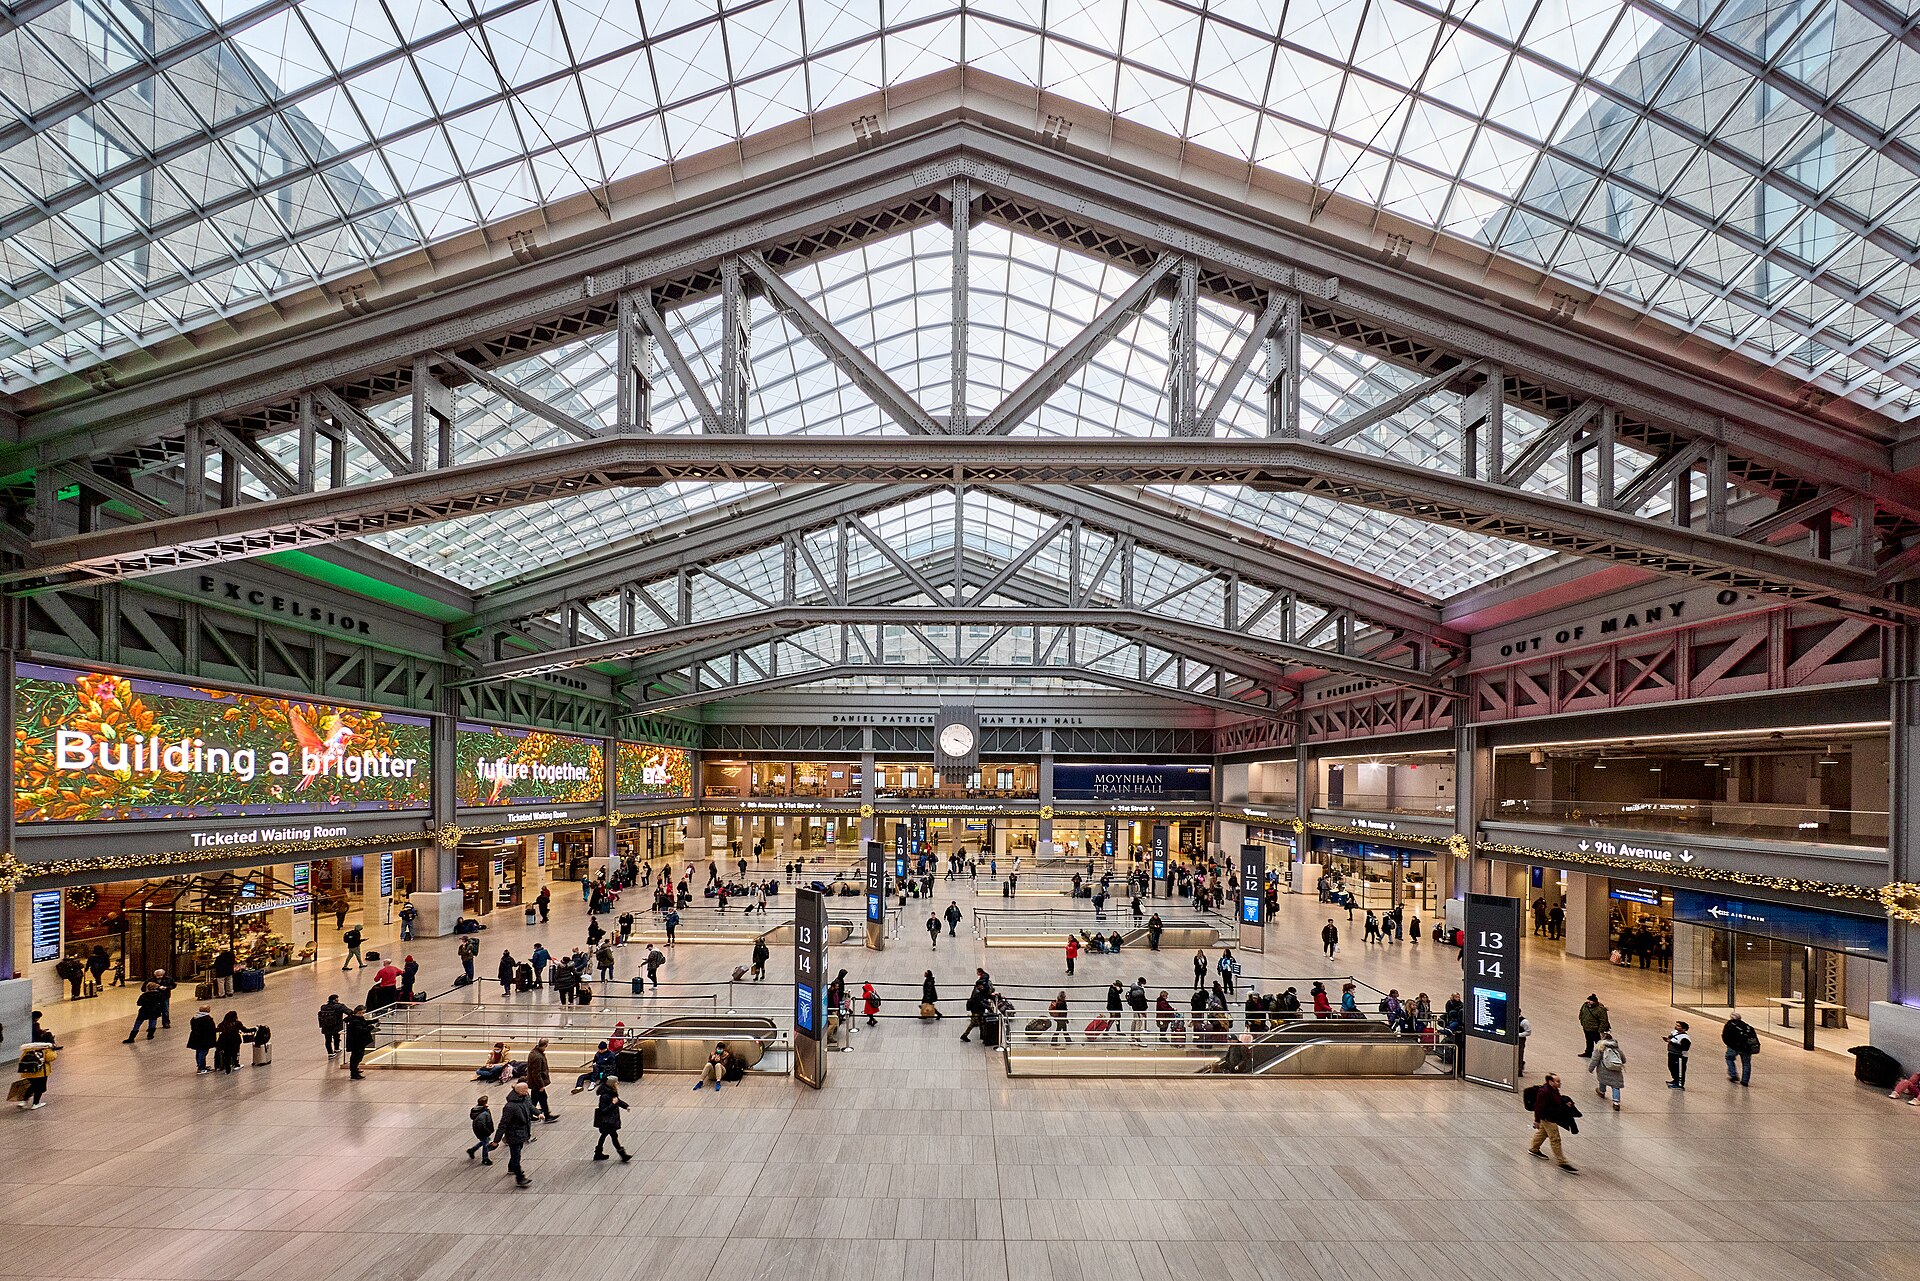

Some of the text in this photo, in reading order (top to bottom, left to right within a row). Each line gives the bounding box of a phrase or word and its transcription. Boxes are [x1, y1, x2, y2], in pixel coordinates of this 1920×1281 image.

[200, 576, 371, 635] EXCELSIOR
[1500, 600, 1685, 657] OUT OF MANY
[545, 673, 587, 690] UPWARD
[832, 715, 934, 724] DANIEL PATRICK
[981, 716, 1083, 725] HAN TRAIN HALL
[55, 729, 417, 783] Building a brighter
[477, 757, 590, 784] future together.
[1095, 774, 1163, 784] MOYNIHAN
[1094, 784, 1164, 794] TRAIN HALL
[508, 811, 567, 823] Ticketed Waiting Room
[191, 825, 347, 848] Ticketed Waiting Room
[1595, 841, 1672, 861] 9th Avenue
[871, 862, 876, 872] 11
[1247, 865, 1256, 875] 11
[870, 878, 877, 888] 12
[1247, 881, 1257, 891] 12
[1731, 912, 1765, 922] AIRTRAIN
[800, 926, 811, 944] 13
[1479, 931, 1503, 949] 13
[799, 955, 811, 973] 14
[1478, 960, 1503, 978] 14
